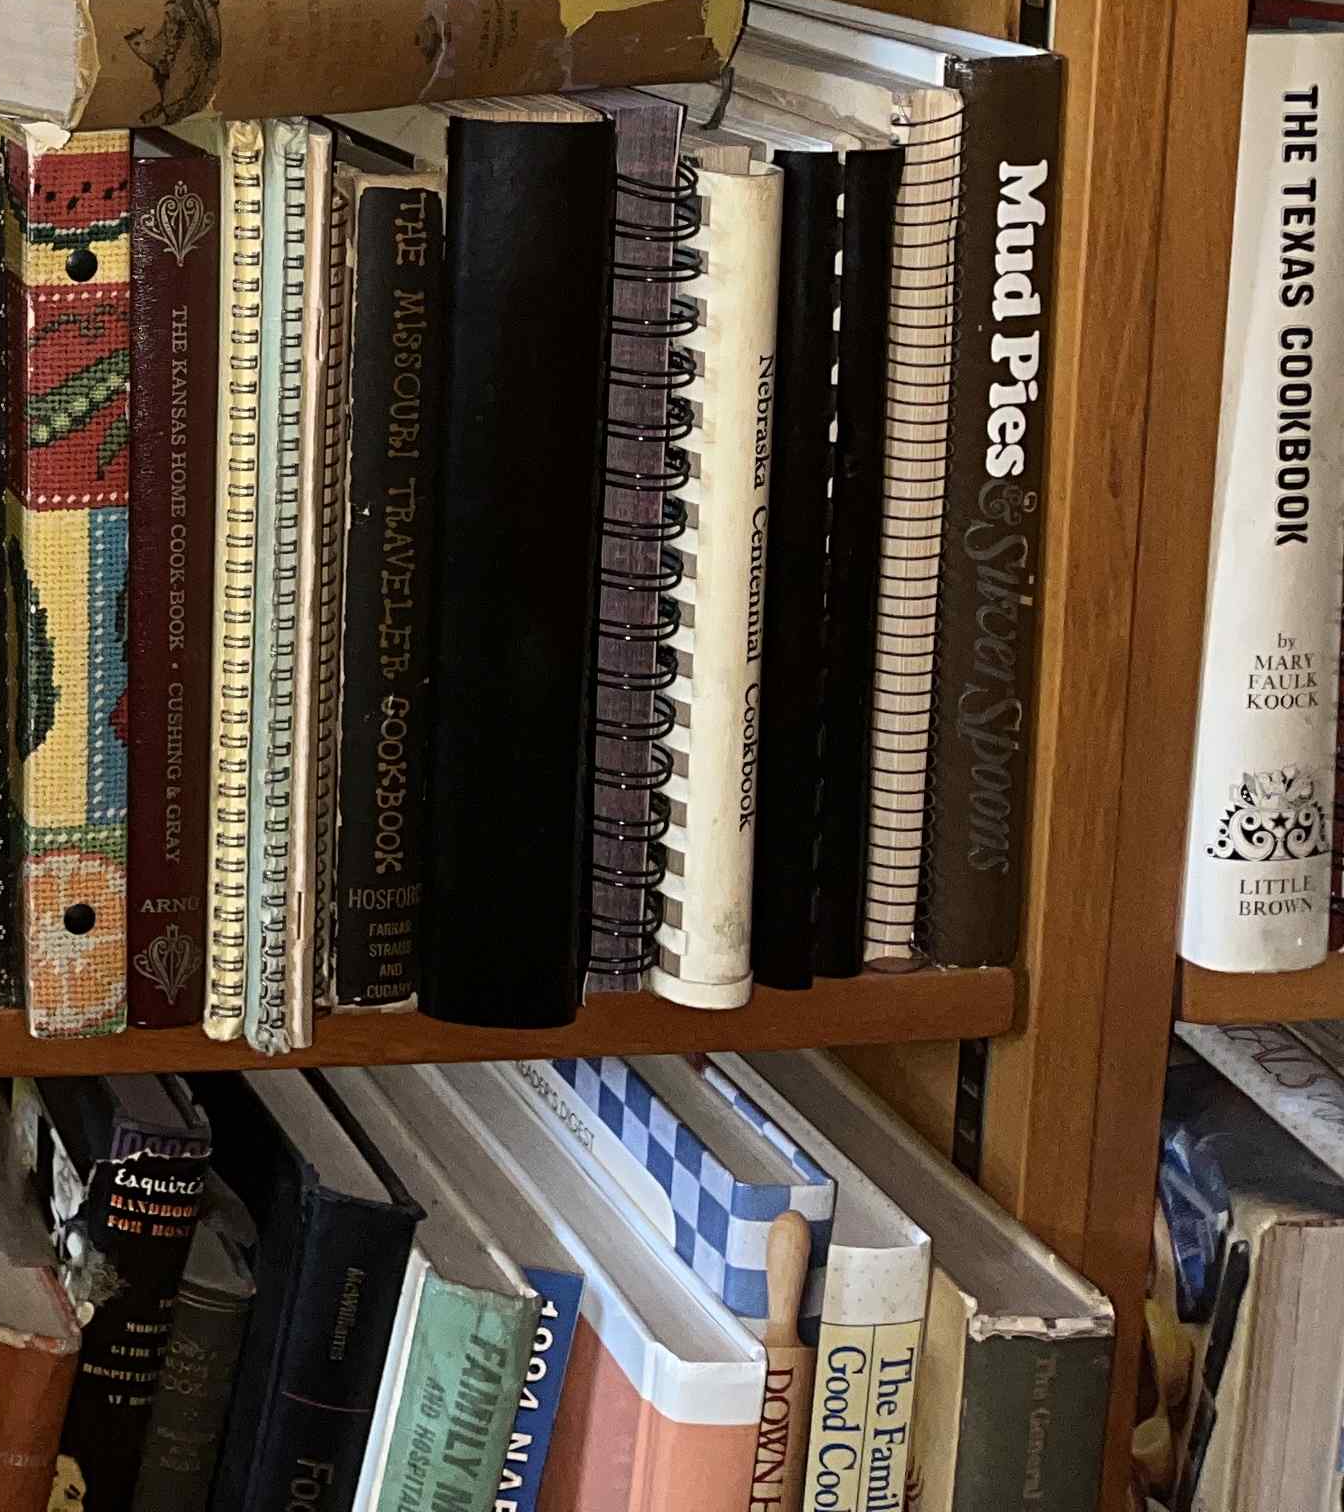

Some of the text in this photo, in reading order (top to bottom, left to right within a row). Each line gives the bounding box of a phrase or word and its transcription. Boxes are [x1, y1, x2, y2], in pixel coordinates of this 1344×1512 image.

[991, 159, 1050, 322] Mud
[1274, 84, 1320, 547] THE TEXAS COOKBOOK
[984, 330, 1041, 479] Pies
[373, 192, 428, 875] THE MISSOURI TRAVELER COOKBOOK
[738, 353, 777, 833] Nebraska Centennial Cookbook
[1246, 692, 1321, 711] KOOCK
[1247, 672, 1318, 691] FAULK
[1254, 652, 1316, 672] MARY
[1238, 877, 1315, 897] LITTLE
[1238, 898, 1315, 918] BROWN
[114, 1168, 206, 1196] Esquire's
[443, 1332, 509, 1480] FAMILY
[822, 1344, 868, 1433] Good
[875, 1346, 915, 1418] The
